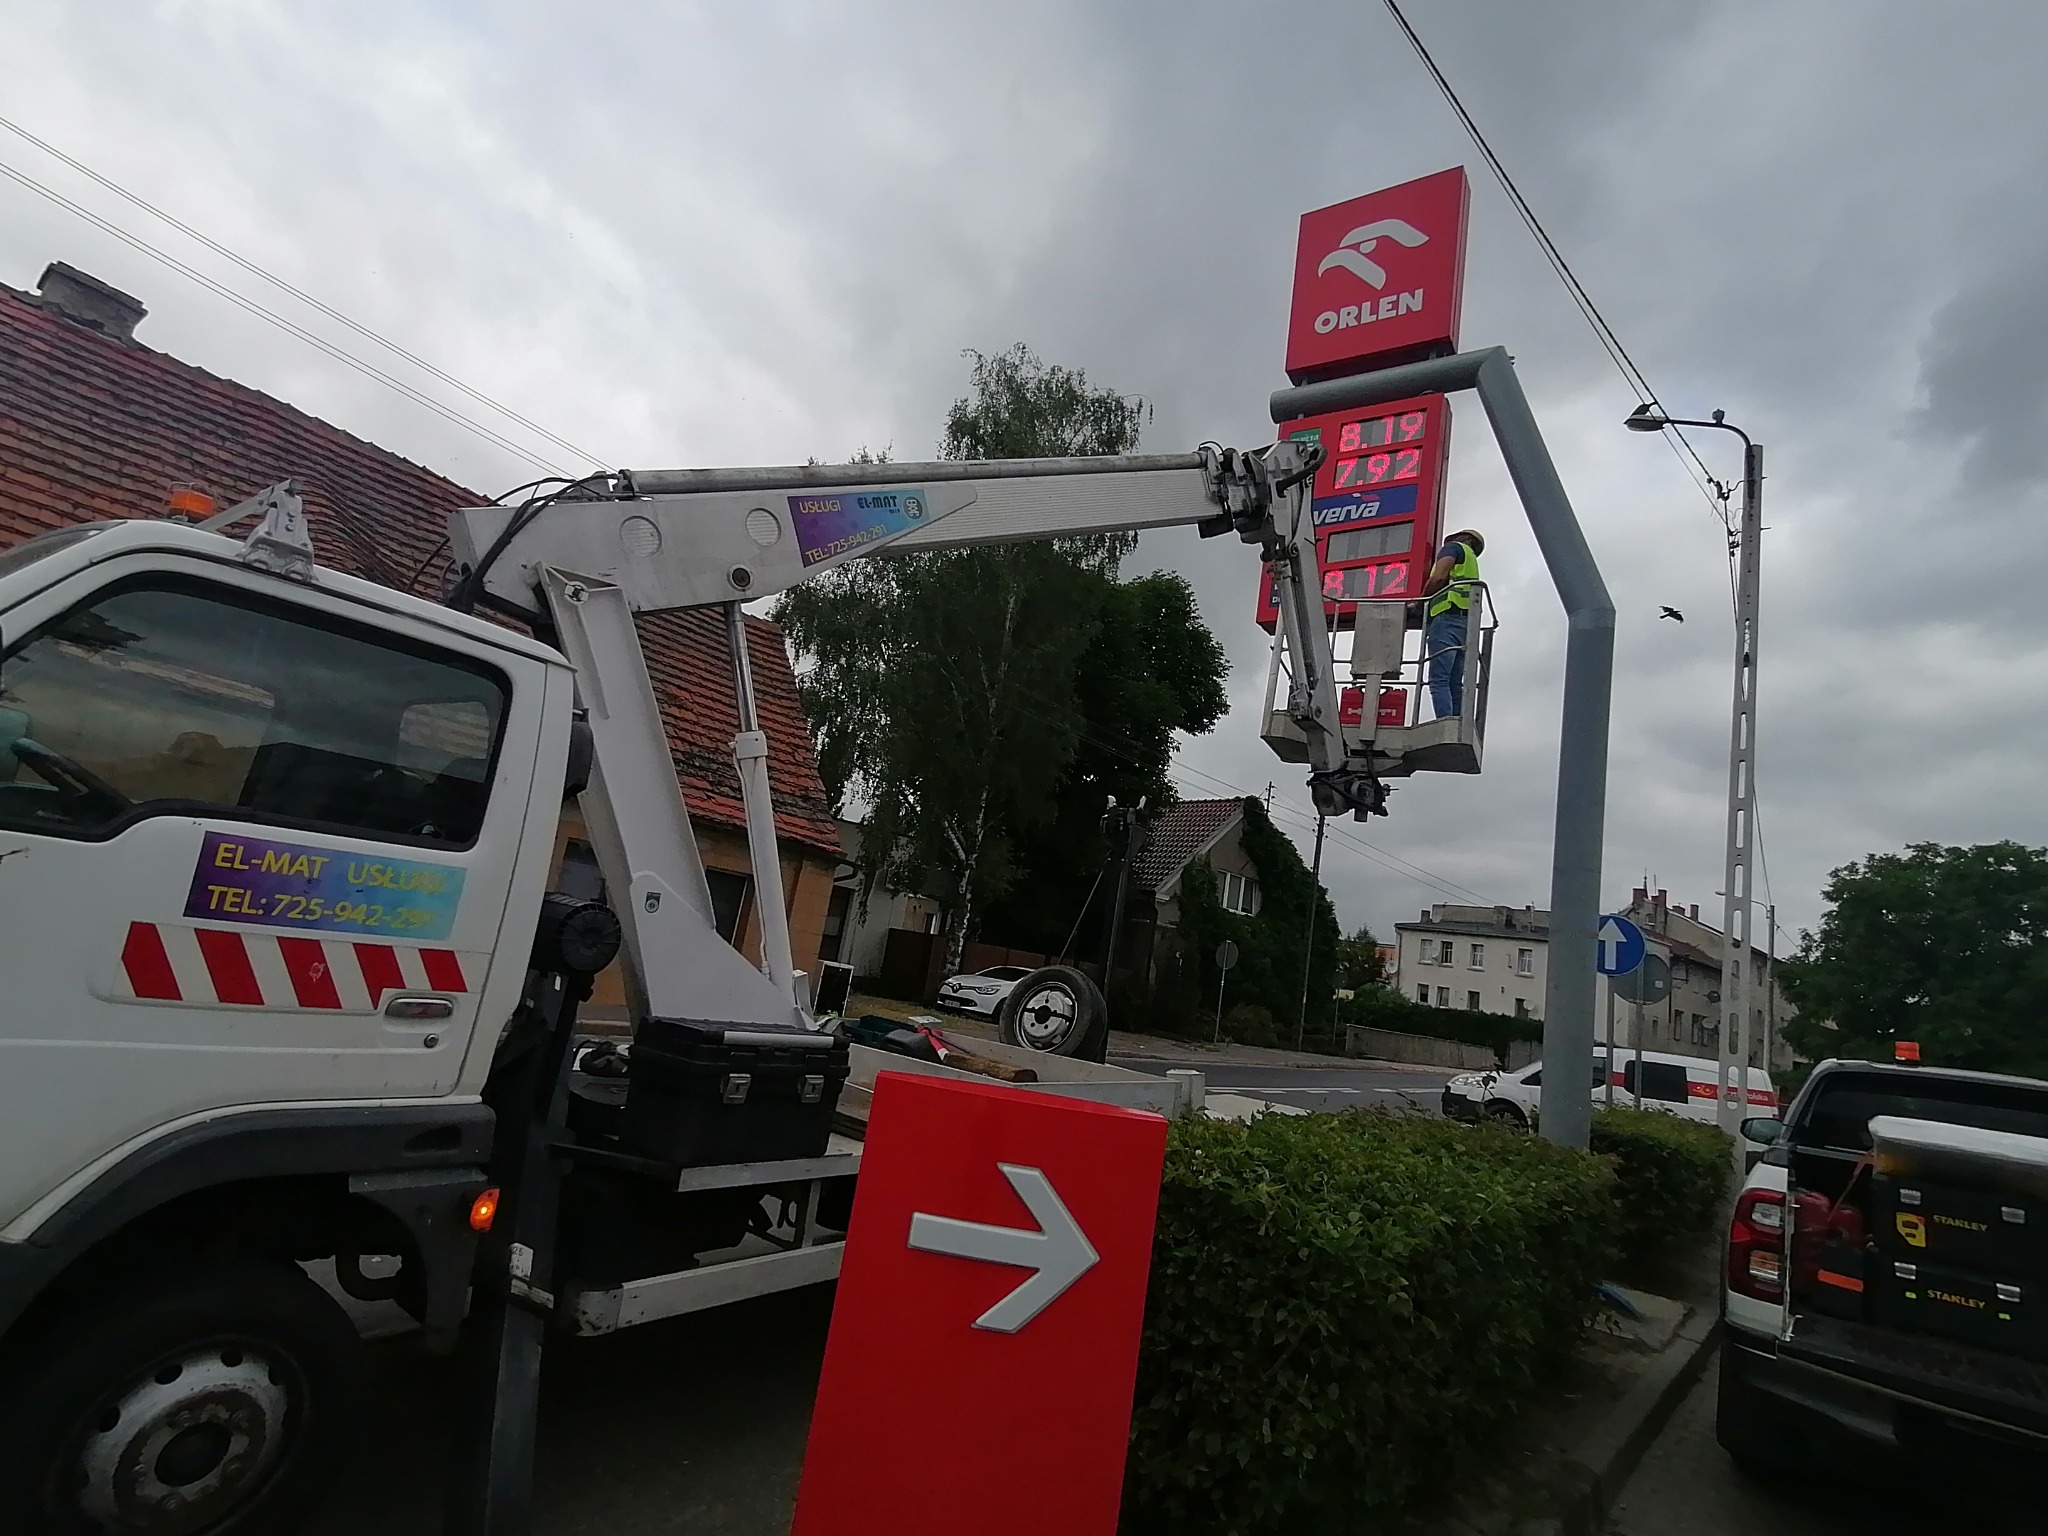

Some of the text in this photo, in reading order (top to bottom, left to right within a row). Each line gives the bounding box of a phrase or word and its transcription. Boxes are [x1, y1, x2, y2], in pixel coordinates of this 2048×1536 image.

[1314, 288, 1424, 334] ORLEN
[1339, 411, 1424, 453] 8.19
[1335, 448, 1420, 490] 7.92
[799, 499, 842, 513] USŁUGI
[1313, 501, 1380, 525] verva
[1323, 562, 1407, 599] 8.12
[214, 842, 330, 879] EL-MAT
[207, 884, 267, 915] TEL:
[1932, 1214, 1988, 1232] STANLEY
[1927, 1289, 1986, 1309] STANLEY
